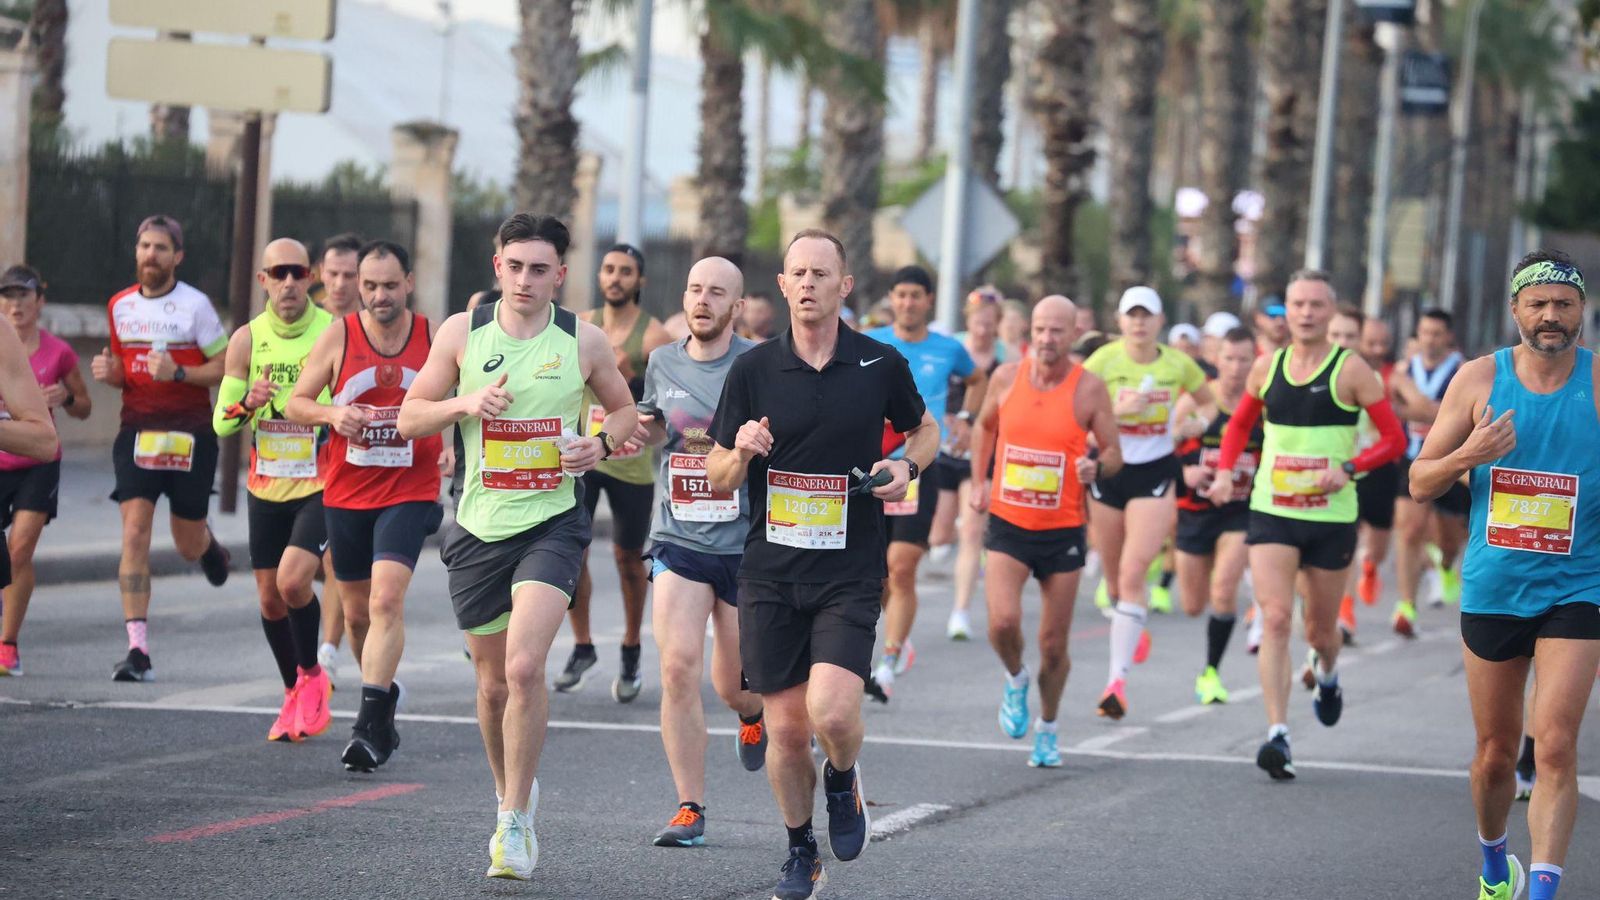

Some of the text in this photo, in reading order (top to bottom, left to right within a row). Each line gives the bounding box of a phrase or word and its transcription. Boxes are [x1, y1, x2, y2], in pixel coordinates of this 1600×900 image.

[361, 427, 398, 440] 14137
[503, 421, 556, 433] GENERALI
[503, 445, 543, 458] 2706
[681, 478, 712, 492] 1571
[789, 476, 841, 490] GENERALI
[1511, 473, 1571, 491] GENERALI
[784, 498, 828, 515] 12062
[1508, 499, 1552, 516] 7827
